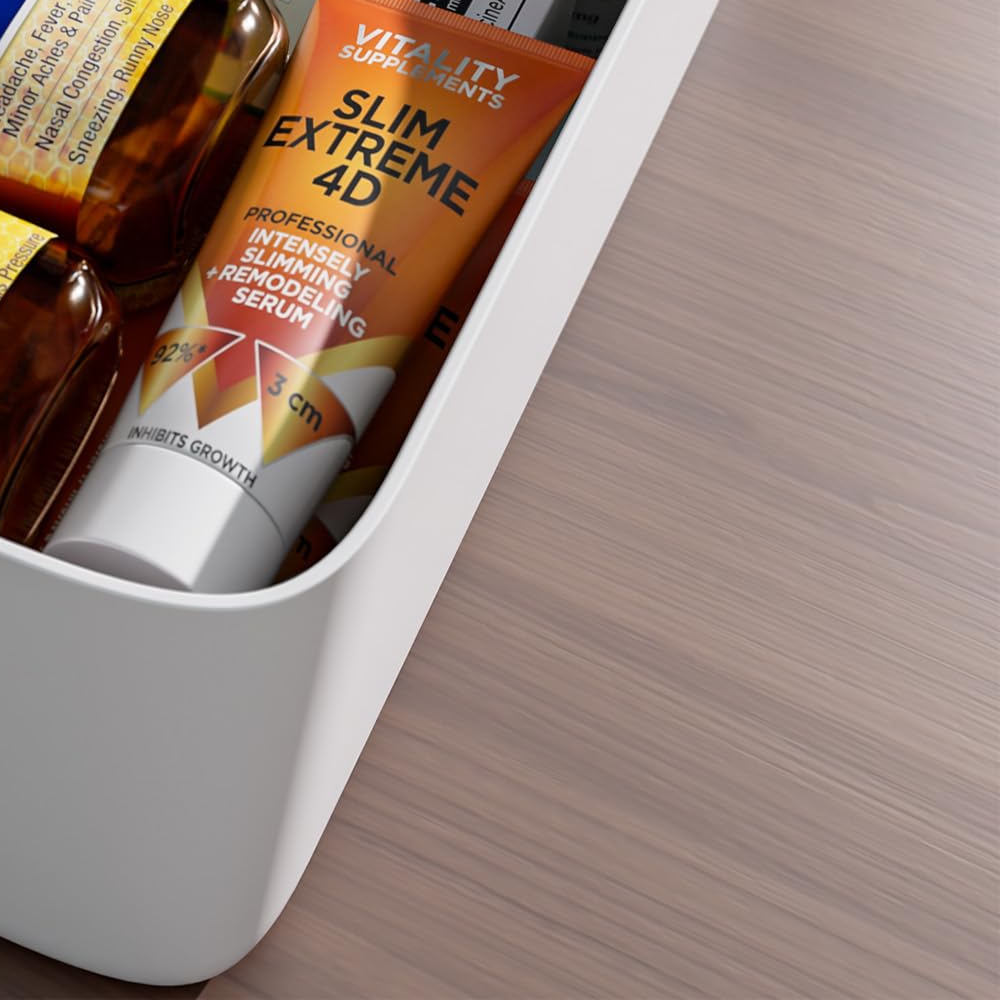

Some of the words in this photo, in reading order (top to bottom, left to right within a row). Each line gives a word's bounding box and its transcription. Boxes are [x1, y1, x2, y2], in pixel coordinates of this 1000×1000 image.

[31, 2, 72, 43] Fever,
[3, 88, 39, 139] Minor
[37, 38, 69, 88] Aches
[61, 24, 77, 38] &
[35, 101, 73, 152] Nasal
[63, 15, 127, 100] Congestion,
[69, 86, 127, 165] Sneezing,
[113, 37, 154, 83] Runny
[142, 3, 175, 38] Nose
[338, 46, 505, 110] SUPPLEMENTS
[355, 24, 520, 92] VITALITY
[334, 89, 450, 150] SLIM
[264, 115, 479, 217] EXTREME
[312, 165, 382, 207] 4D
[0, 232, 45, 281] Pressure
[244, 207, 398, 276] PROFESSIONAL
[248, 228, 370, 281] INTENSELY
[240, 247, 352, 299] SLIMMING
[232, 288, 314, 329] SERUM
[266, 372, 288, 397] 3
[288, 392, 323, 431] cm
[128, 425, 189, 449] INHIBITS
[190, 440, 257, 488] GROWTH
